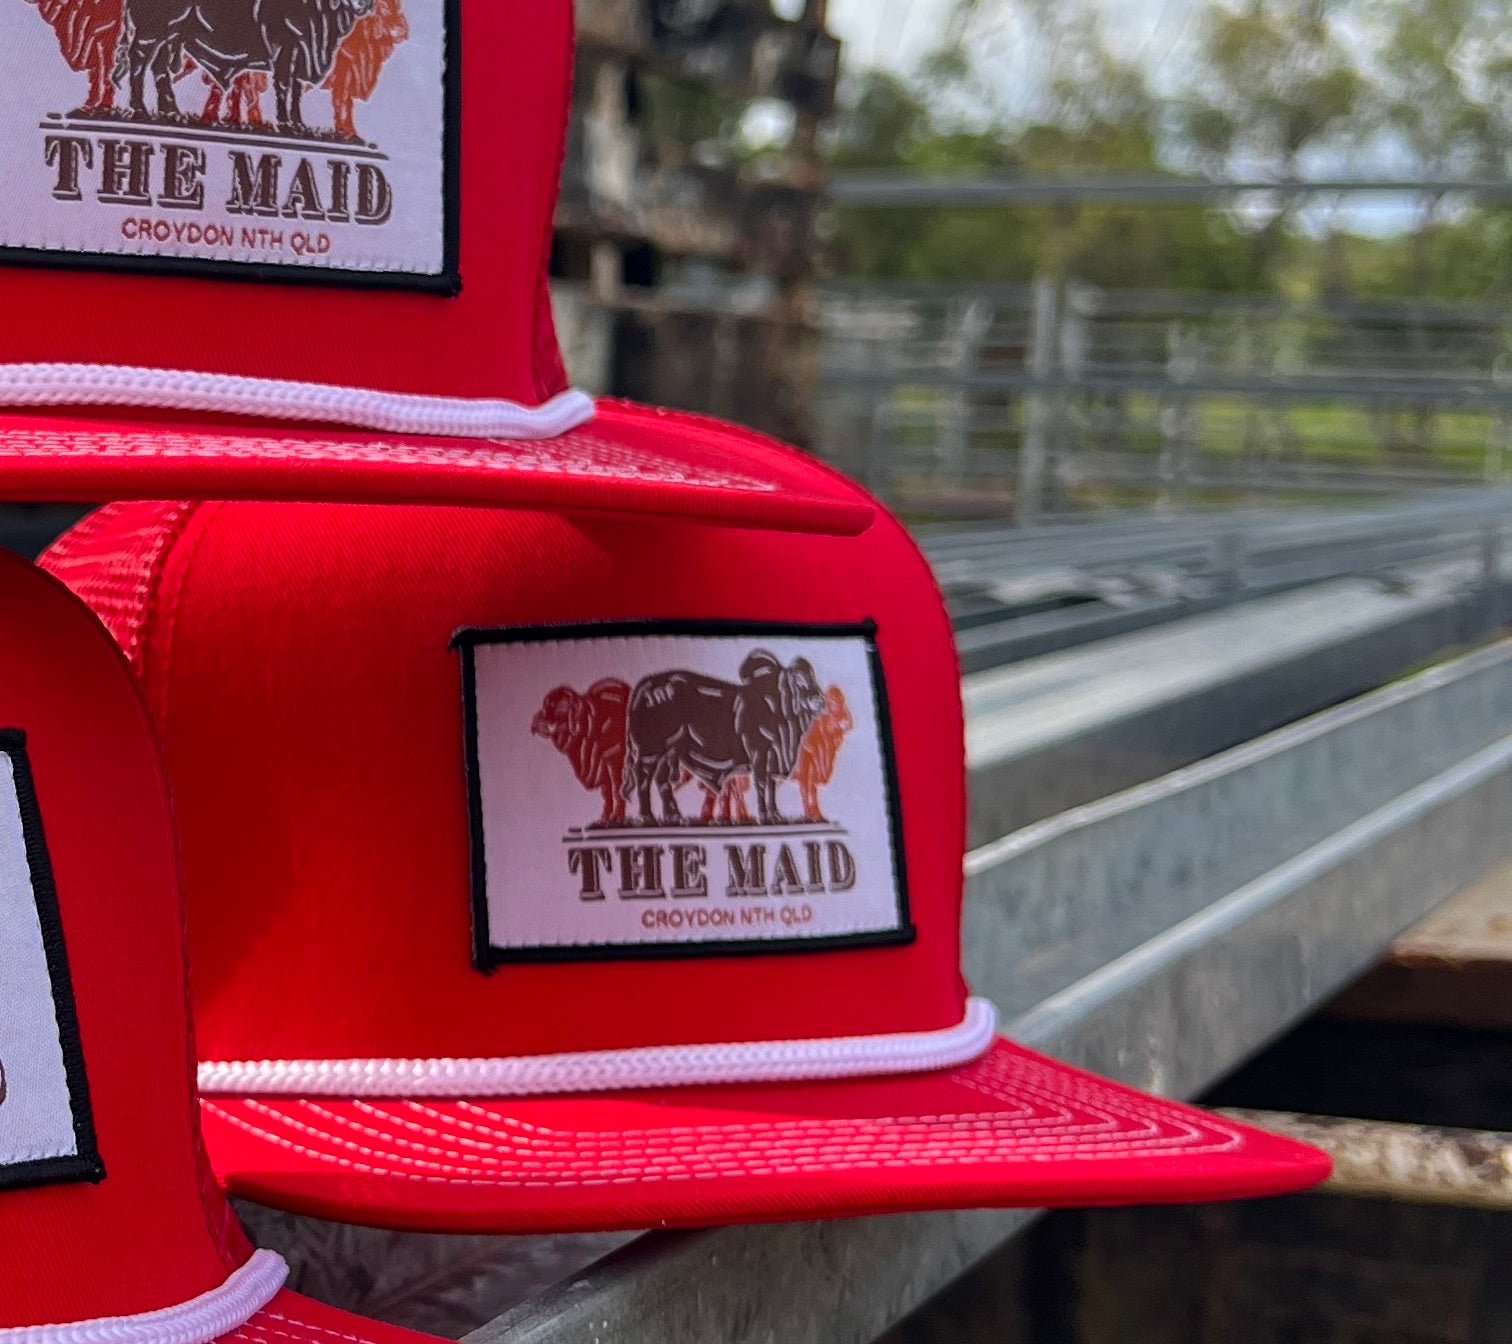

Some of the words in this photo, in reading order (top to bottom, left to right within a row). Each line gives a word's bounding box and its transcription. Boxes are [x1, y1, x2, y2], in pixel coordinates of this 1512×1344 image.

[44, 135, 206, 211] THE
[225, 150, 392, 226] MAID
[120, 217, 234, 248] CROYDON
[240, 229, 283, 251] NTH
[289, 232, 331, 257] QLD
[567, 843, 708, 901] THE
[724, 840, 857, 897] MAID
[641, 908, 735, 929] CROYDON
[739, 906, 775, 926] NTH
[780, 905, 813, 926] QLD
